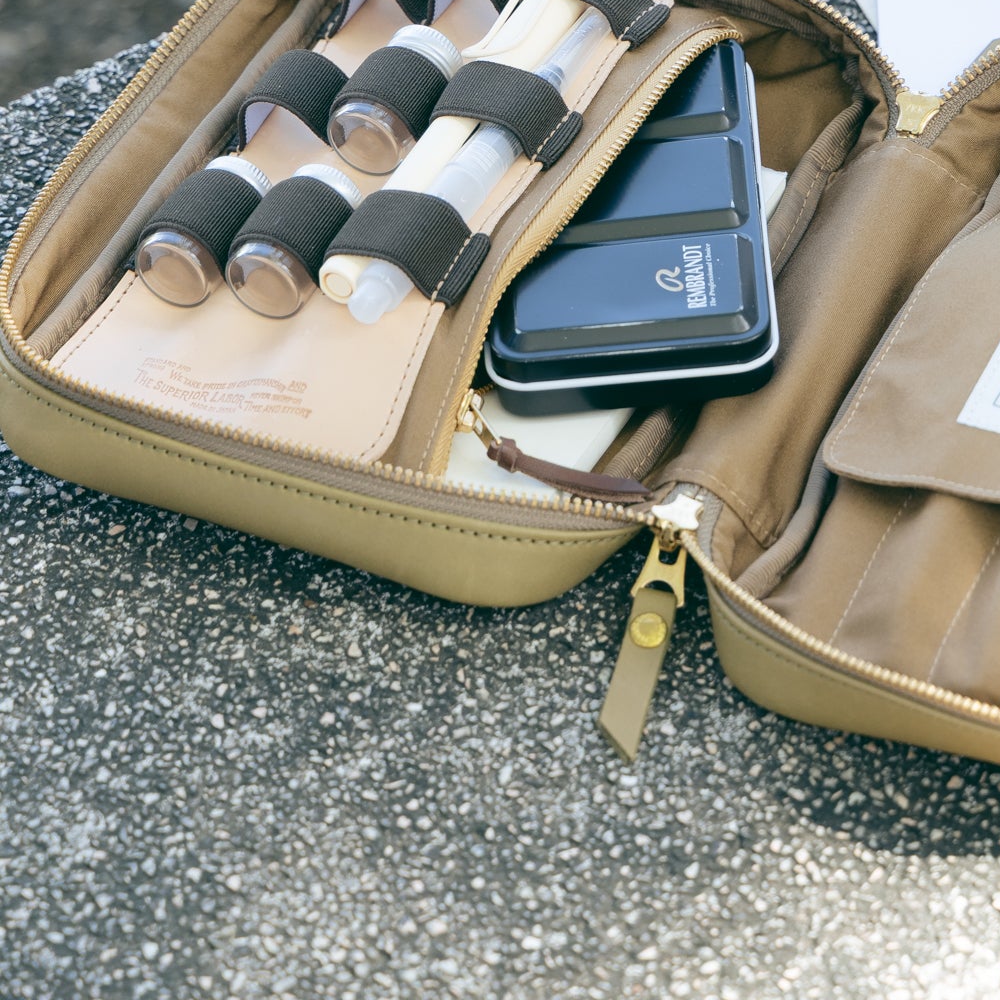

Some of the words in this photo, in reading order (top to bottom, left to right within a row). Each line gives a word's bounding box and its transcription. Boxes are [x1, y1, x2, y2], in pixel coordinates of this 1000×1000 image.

[682, 244, 708, 309] REMBRANDT
[134, 368, 154, 388] THE
[153, 380, 209, 403] SUPERIOR
[210, 391, 246, 409] LABOR
